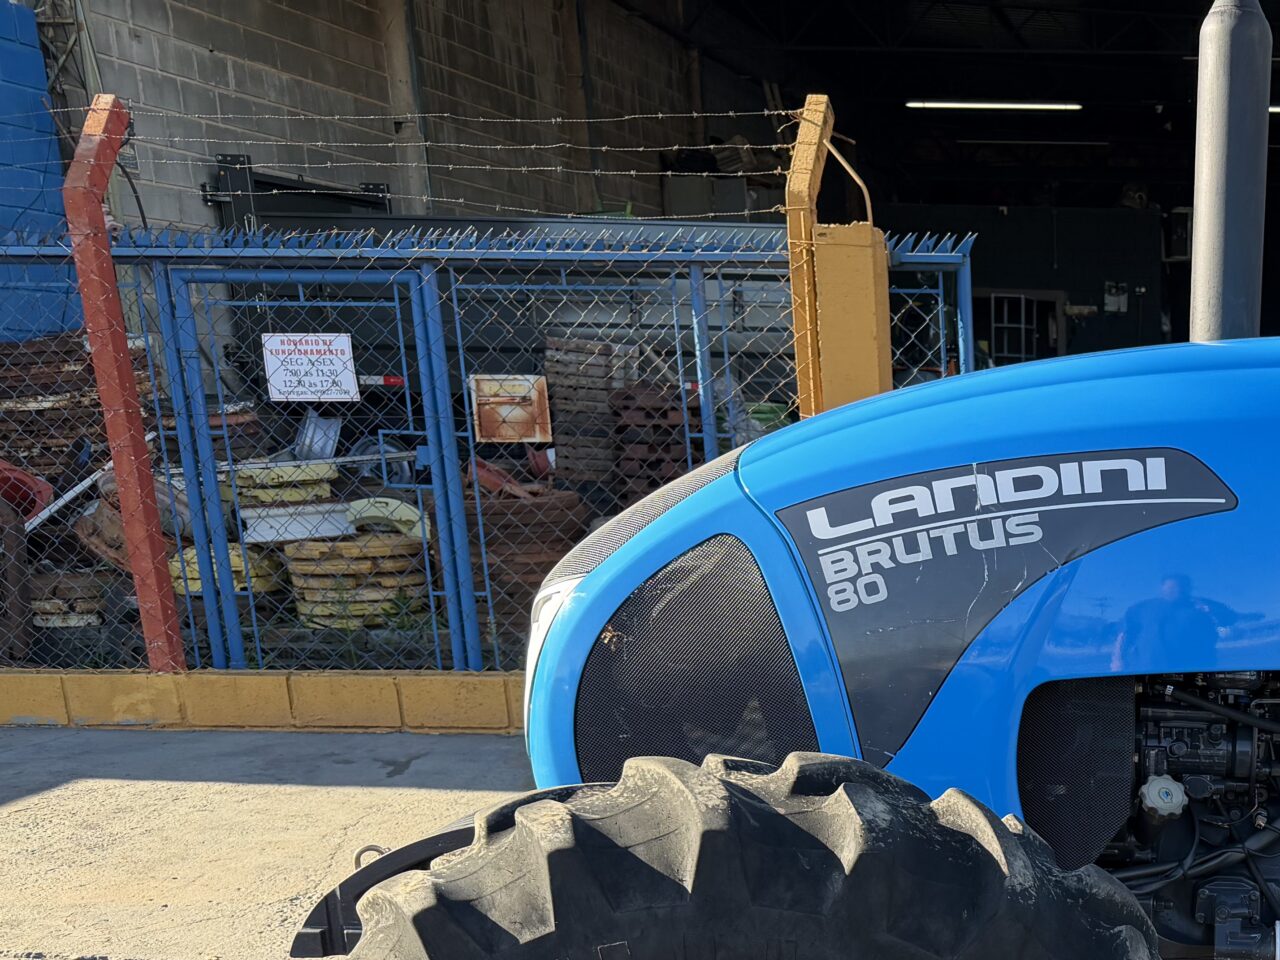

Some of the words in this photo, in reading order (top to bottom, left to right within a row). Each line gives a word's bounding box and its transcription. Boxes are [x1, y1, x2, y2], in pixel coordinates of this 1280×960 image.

[270, 348, 346, 356] FUNCIONAMENTO
[282, 358, 304, 366] SEG
[316, 358, 335, 367] SEX
[805, 456, 1168, 541] LANDINI
[818, 513, 1044, 584] BRUTUS
[826, 572, 889, 613] 80
